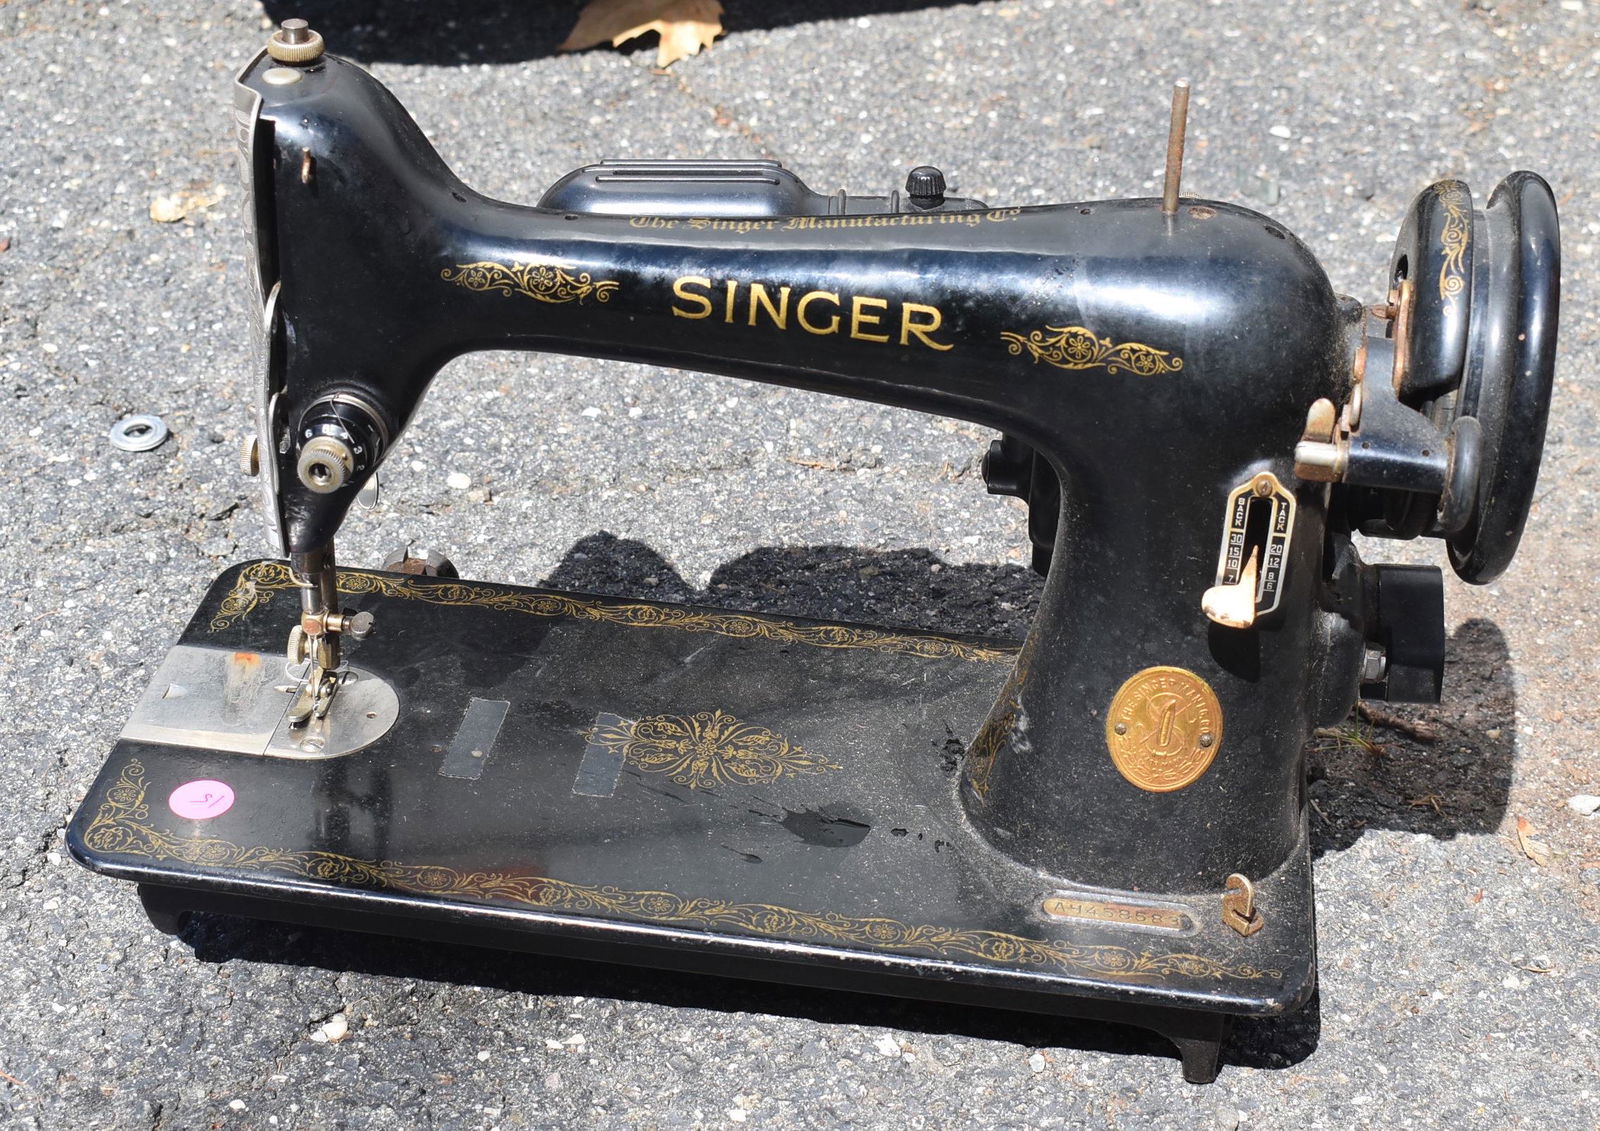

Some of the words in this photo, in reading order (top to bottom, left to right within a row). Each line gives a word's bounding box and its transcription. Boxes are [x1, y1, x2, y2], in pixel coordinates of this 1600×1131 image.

[629, 216, 680, 230] The
[683, 217, 780, 235] Singer
[781, 213, 981, 232] Manufacturing
[671, 275, 955, 351] SINGER
[305, 429, 313, 438] 6
[353, 445, 362, 454] 3
[1234, 497, 1245, 527] BACK
[1276, 502, 1287, 531] TACK
[1230, 534, 1243, 544] 30
[1229, 547, 1240, 556] 15
[1270, 544, 1283, 554] 20
[1227, 559, 1238, 568] 10
[1269, 558, 1280, 567] 12
[1267, 571, 1275, 580] 8
[1266, 582, 1273, 590] 6
[1121, 698, 1138, 721] THE
[1133, 677, 1176, 701] SINGER
